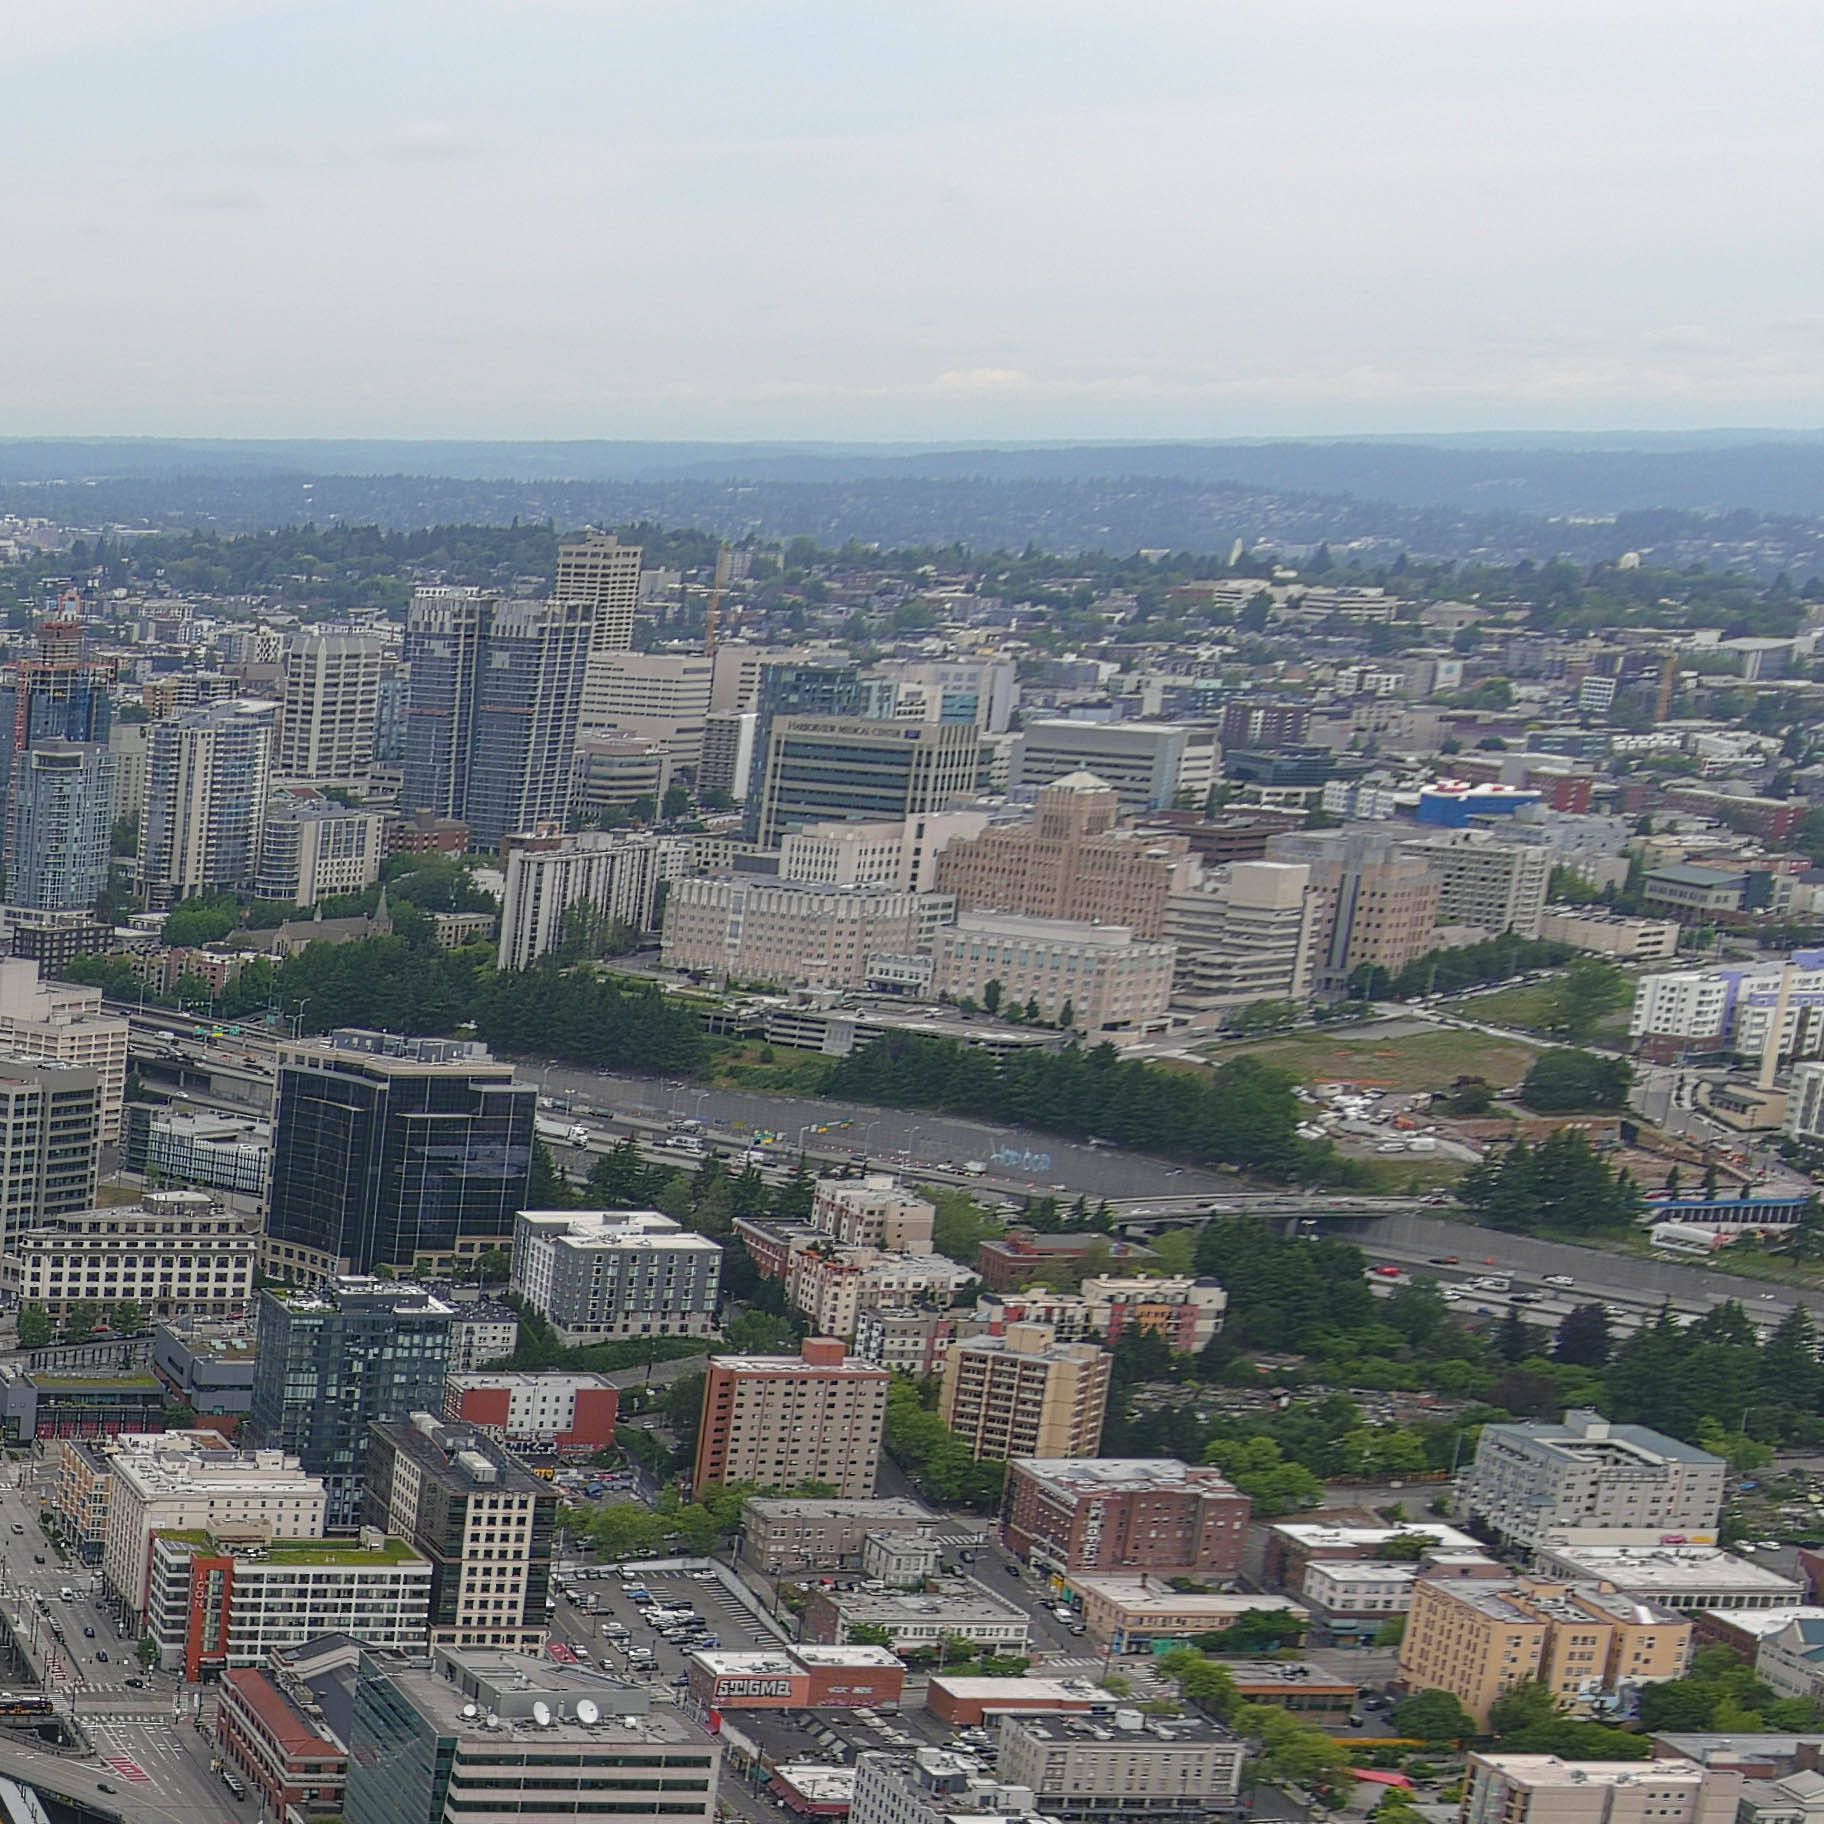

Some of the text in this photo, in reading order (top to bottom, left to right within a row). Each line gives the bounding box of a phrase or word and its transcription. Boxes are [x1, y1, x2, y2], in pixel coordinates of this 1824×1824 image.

[838, 724, 871, 737] MEDICAL
[874, 727, 900, 738] CENTER
[194, 1572, 205, 1608] ICON
